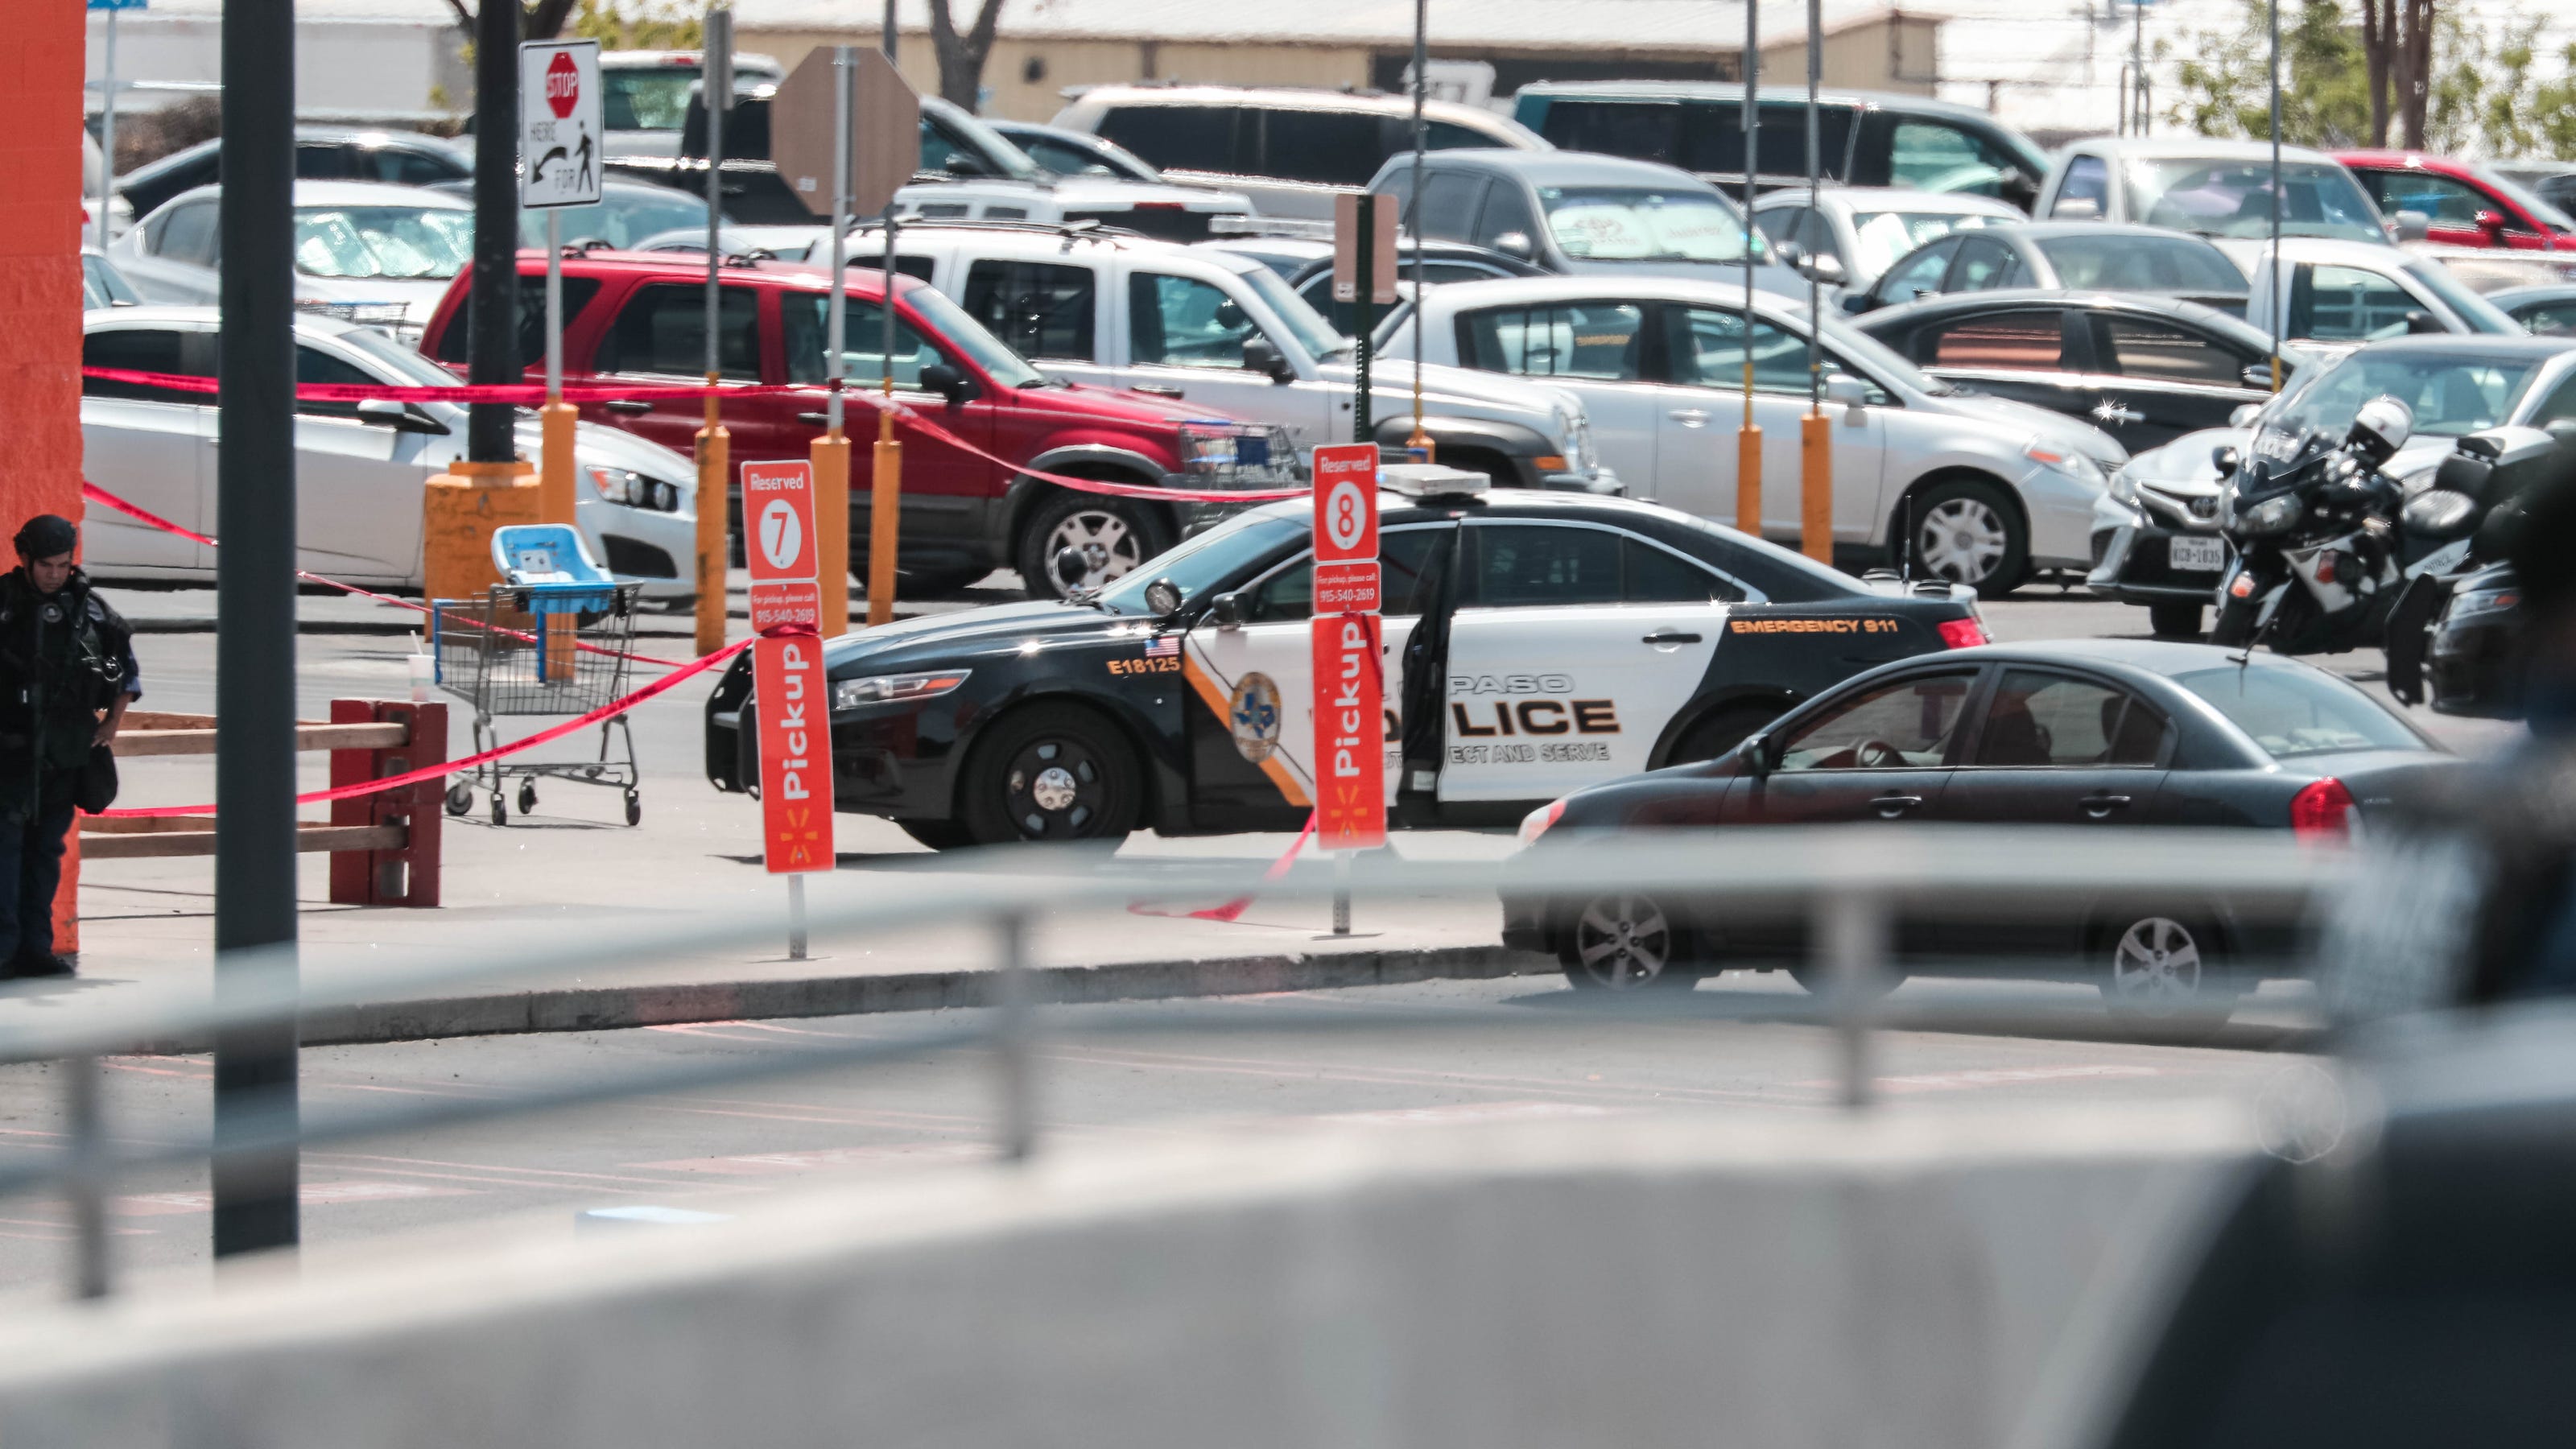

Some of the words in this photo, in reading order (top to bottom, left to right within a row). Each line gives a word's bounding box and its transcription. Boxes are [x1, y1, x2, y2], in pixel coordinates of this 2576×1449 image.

[547, 72, 577, 97] STOP
[530, 122, 556, 142] HERE
[555, 168, 575, 189] FOR
[1320, 455, 1371, 473] Reserved
[750, 472, 804, 490] Reserved
[1338, 493, 1354, 538] 8
[771, 512, 788, 556] 7
[1348, 574, 1365, 584] please
[785, 594, 803, 605] please
[1319, 588, 1375, 603] 915-540-2619
[757, 608, 815, 623] 915-540-2619
[1731, 620, 1859, 634] EMERGENCY
[1863, 619, 1898, 633] 911
[1106, 657, 1181, 675] E18125
[1449, 674, 1575, 696] PASO
[1335, 621, 1367, 777] Pickup
[780, 643, 810, 800] Pickup
[1384, 698, 1622, 742] LICE
[1492, 744, 1535, 763] AND
[1540, 741, 1611, 762] SERVE
